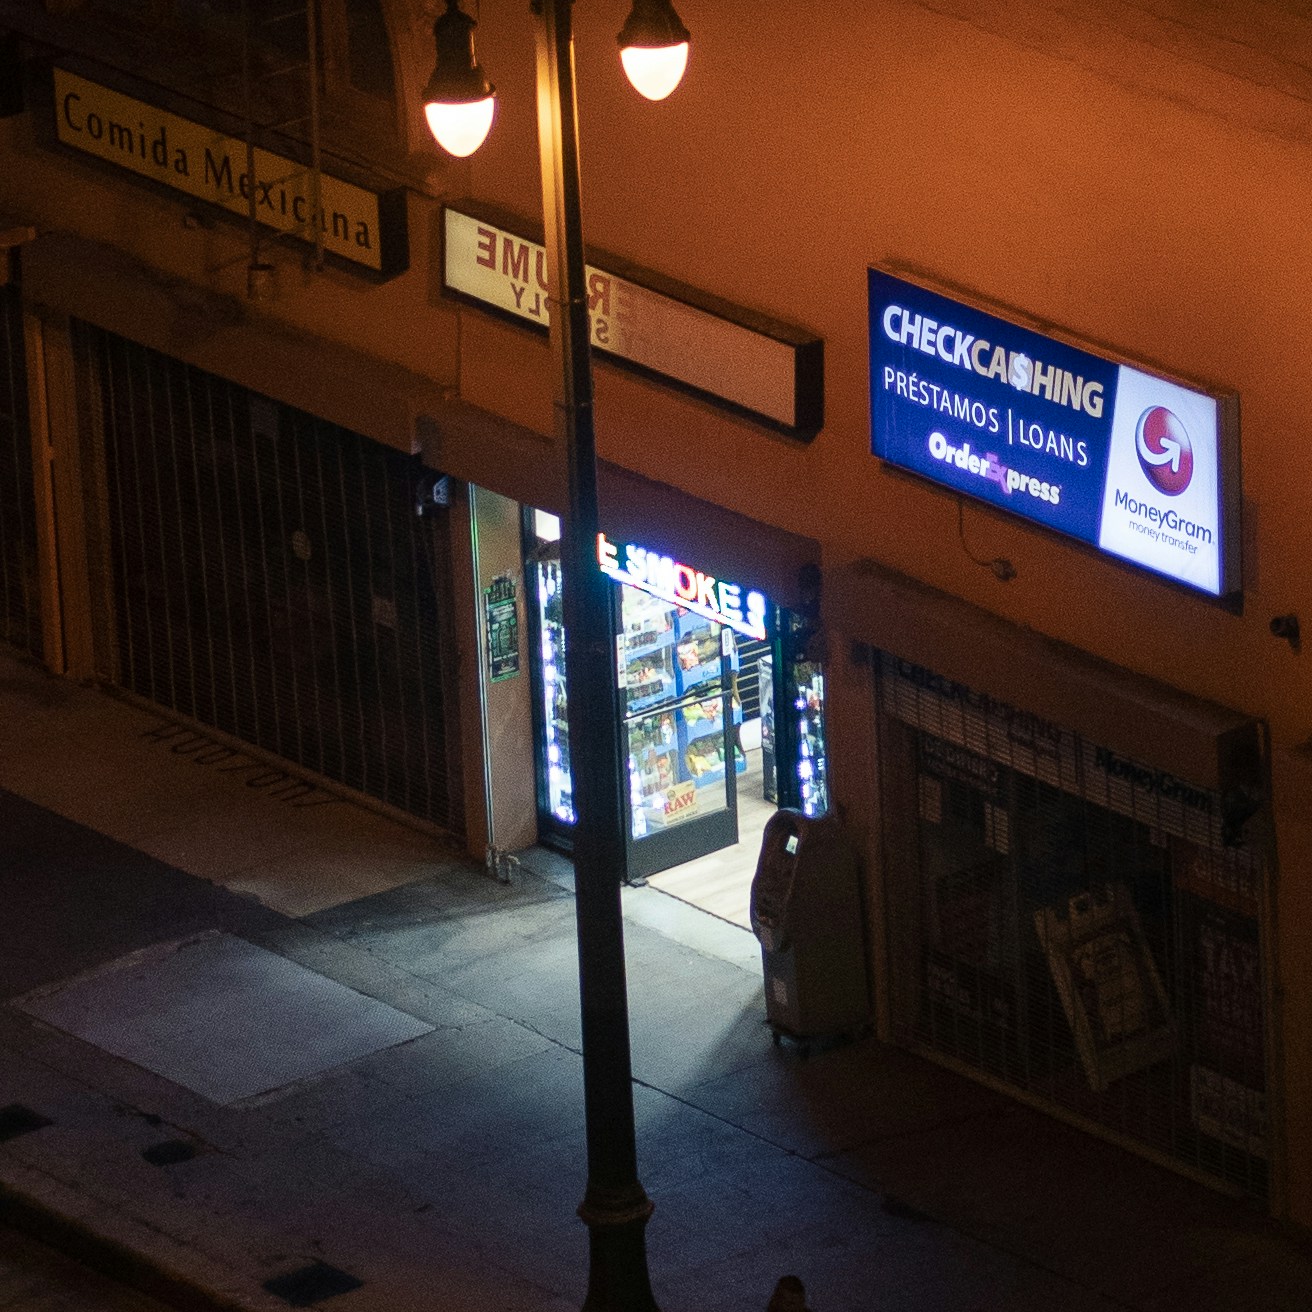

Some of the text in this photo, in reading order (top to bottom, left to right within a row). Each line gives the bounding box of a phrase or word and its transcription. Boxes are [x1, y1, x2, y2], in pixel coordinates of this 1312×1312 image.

[64, 92, 190, 177] Comida
[883, 366, 1087, 467] PRÉSTAMOS LOANS
[928, 432, 1060, 504] OrderExpress
[1114, 488, 1213, 545] MoneyGram
[1129, 522, 1199, 555] money transfer
[664, 790, 695, 815] RAW
